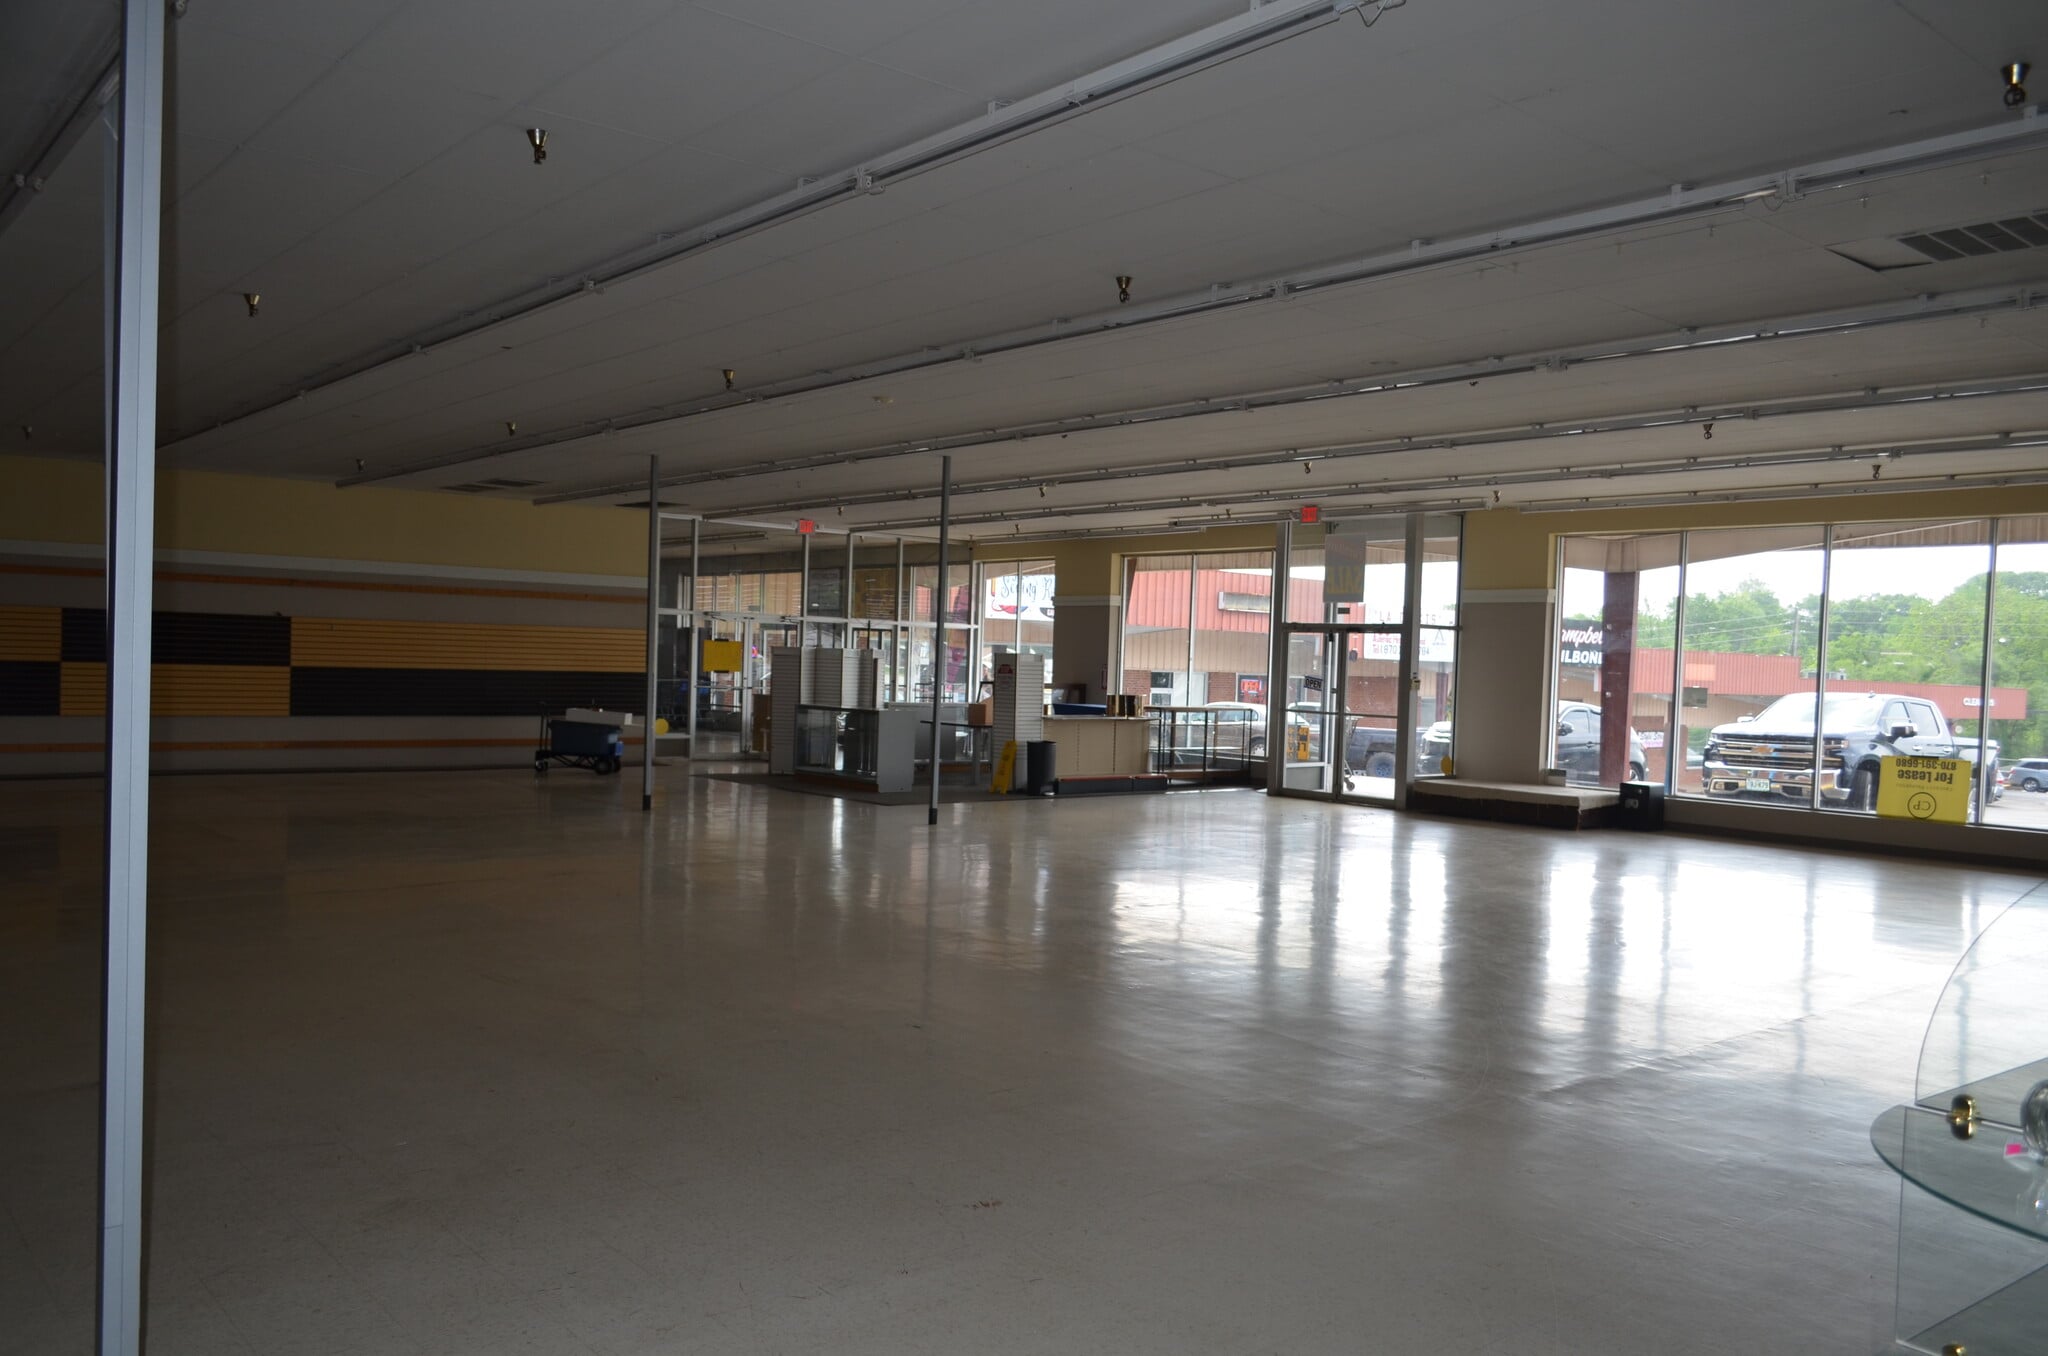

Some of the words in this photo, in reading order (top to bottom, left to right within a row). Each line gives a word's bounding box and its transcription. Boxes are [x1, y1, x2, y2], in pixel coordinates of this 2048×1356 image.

[1304, 677, 1322, 690] OPEN
[1897, 769, 1932, 783] Lease
[1934, 772, 1953, 784] For
[1912, 799, 1931, 811] CP
